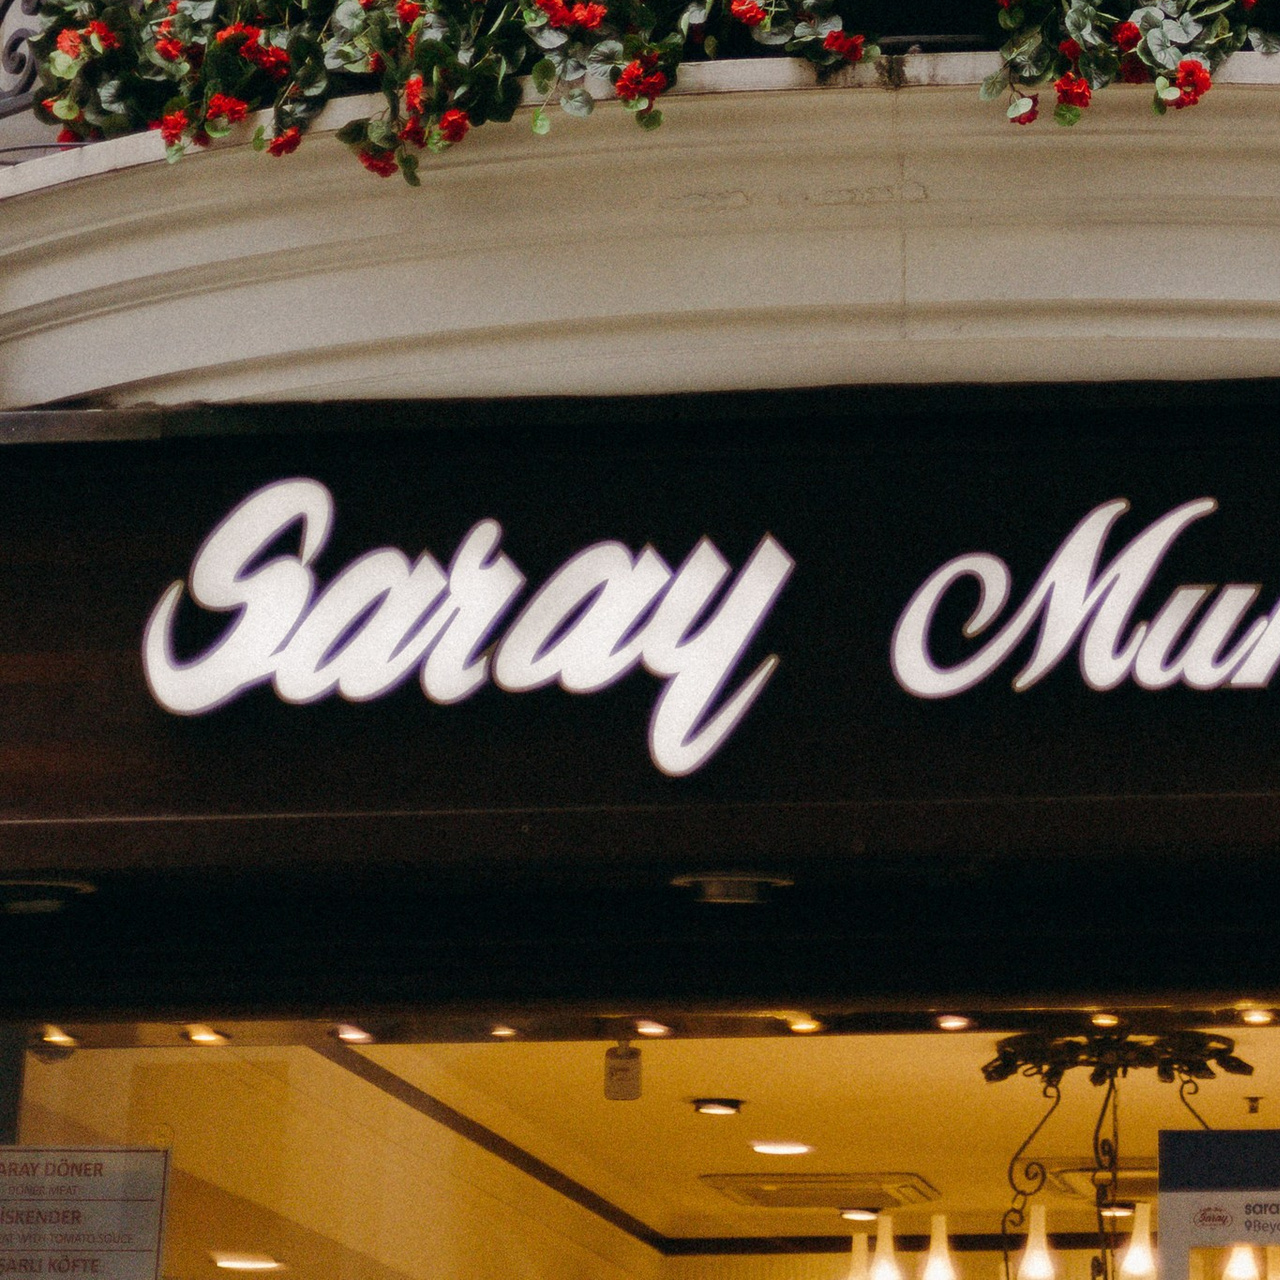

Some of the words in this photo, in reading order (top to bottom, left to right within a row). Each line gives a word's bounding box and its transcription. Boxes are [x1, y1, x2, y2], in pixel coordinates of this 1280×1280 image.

[142, 477, 796, 777] Saray
[45, 1158, 104, 1177] DÖNER
[48, 1255, 100, 1274] KÖFTE
